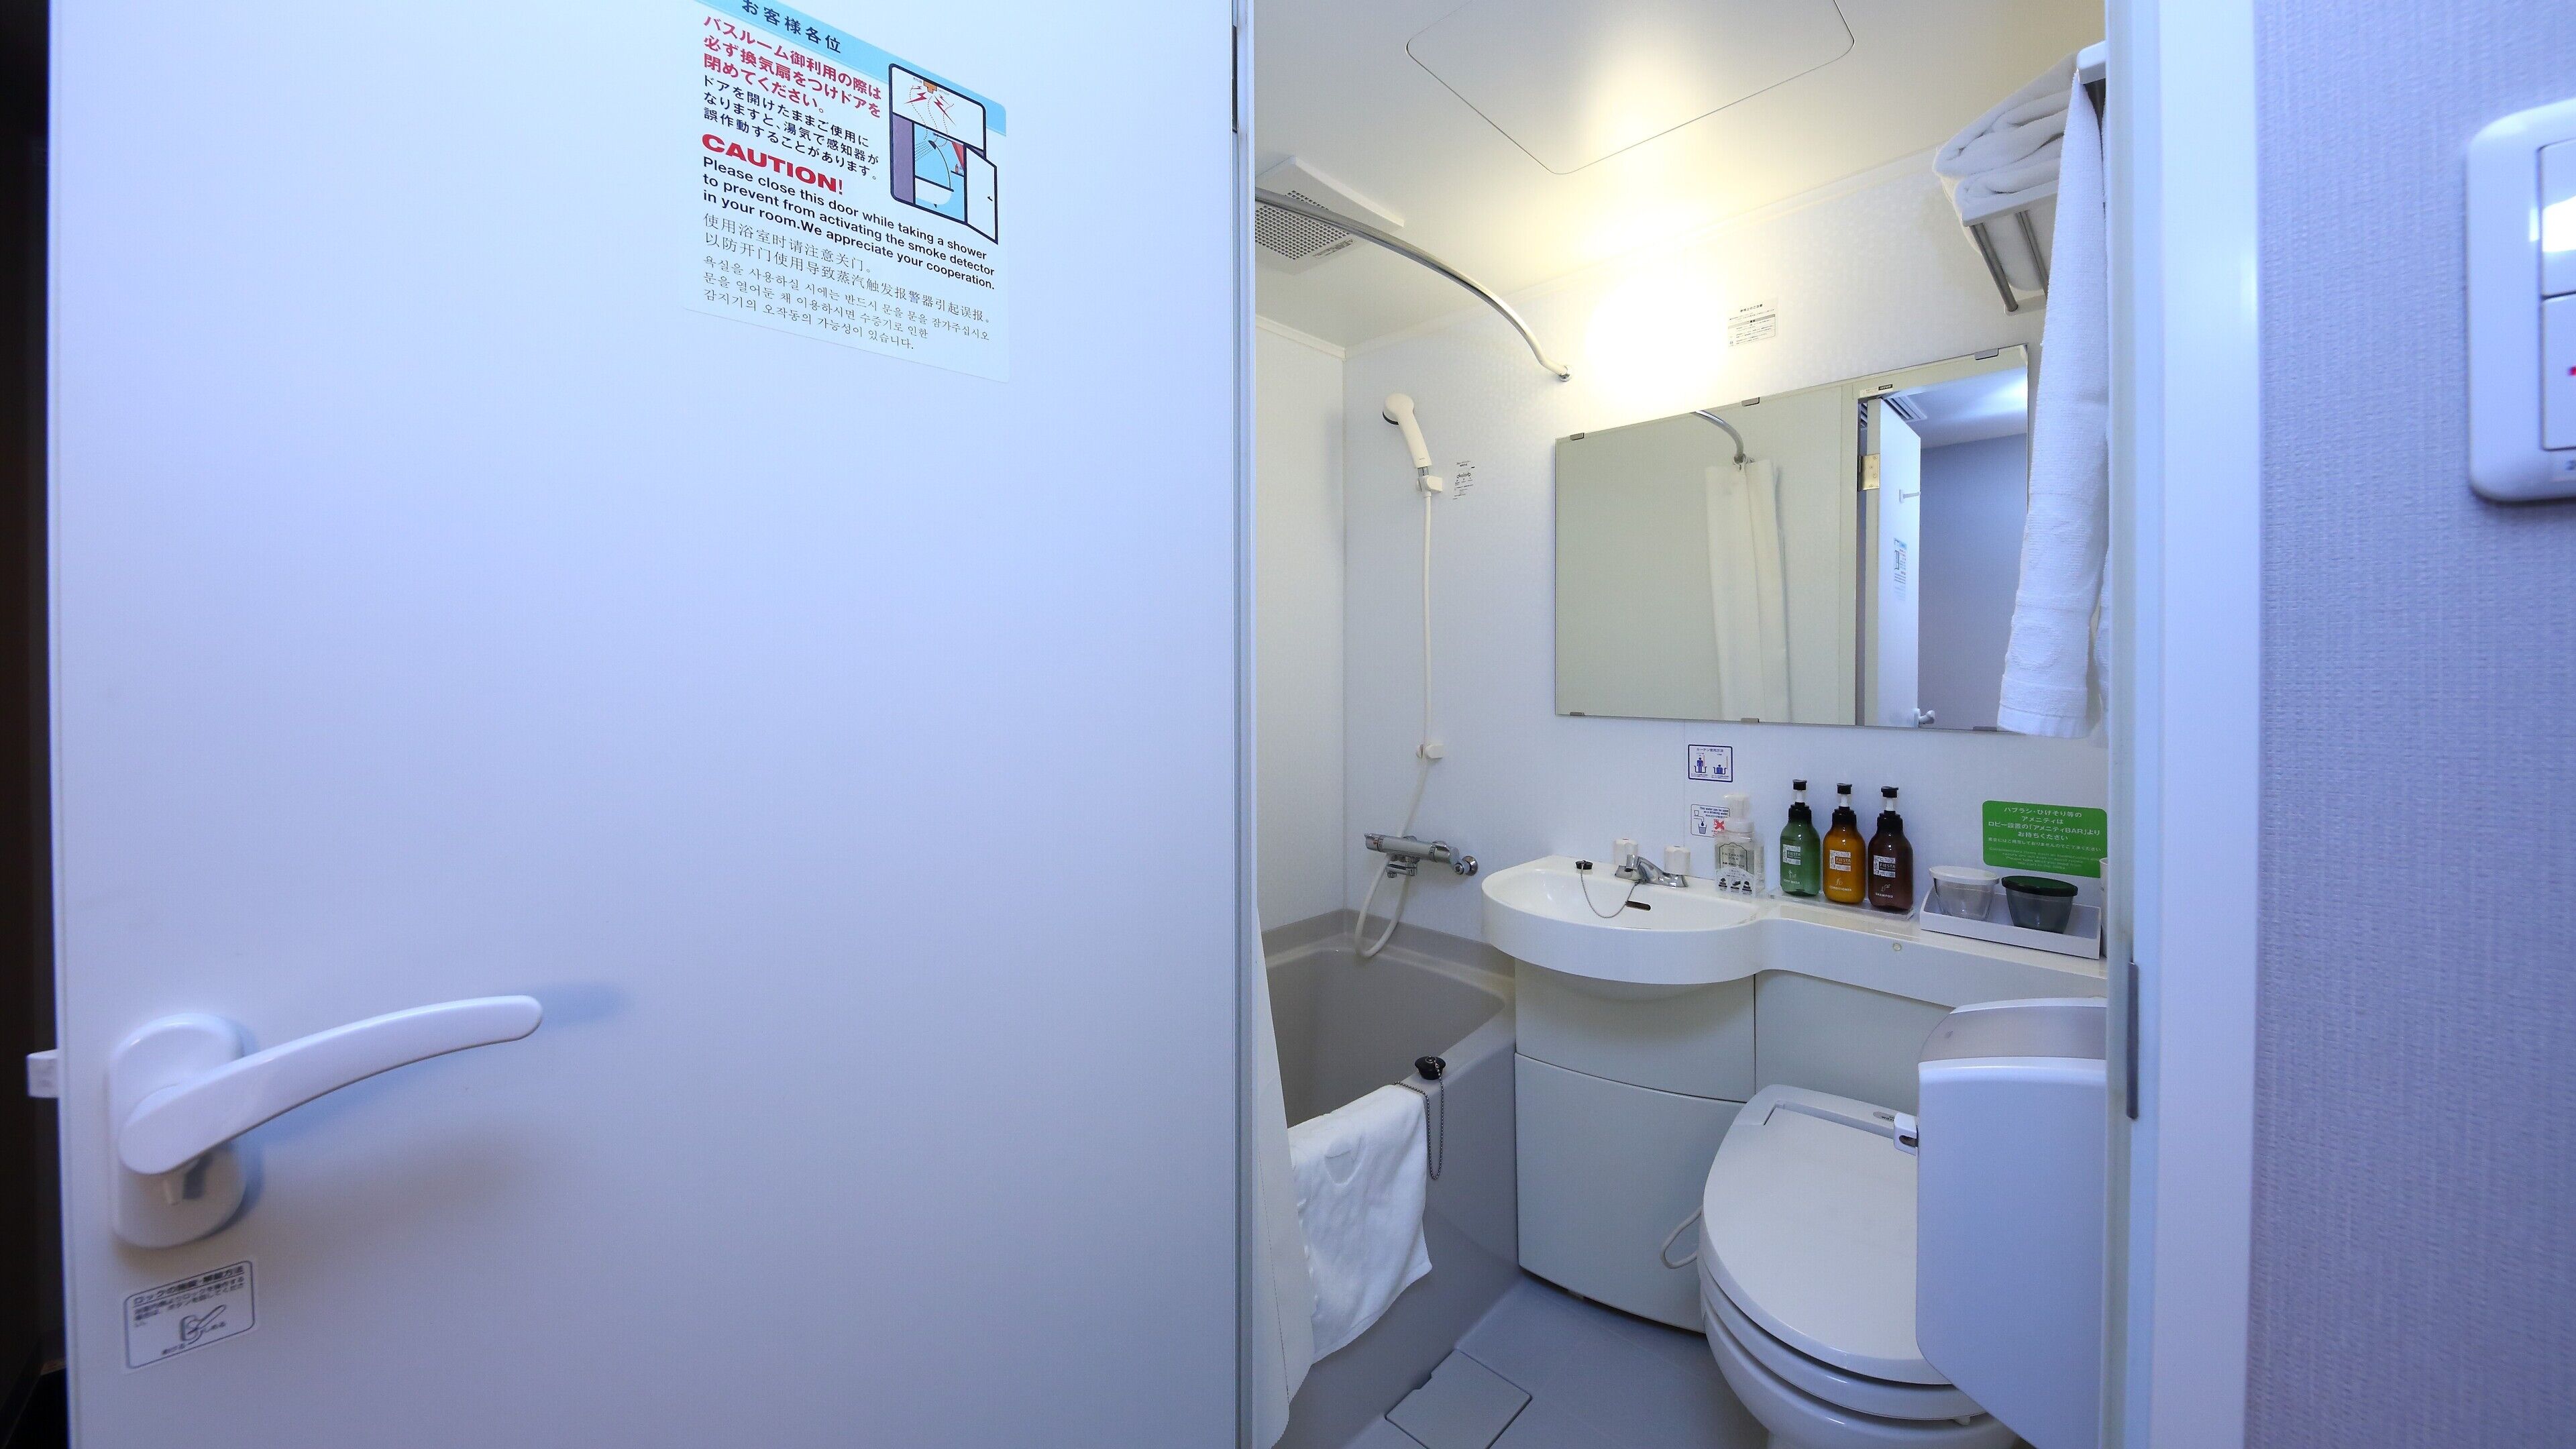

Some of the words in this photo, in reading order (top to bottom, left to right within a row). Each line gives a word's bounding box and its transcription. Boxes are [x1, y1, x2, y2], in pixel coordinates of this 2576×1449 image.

[704, 16, 881, 100] バスルーム御利用の際は
[742, 0, 841, 54] お客様各位
[704, 35, 880, 118] 必ず換気扇をつけドアを
[704, 53, 824, 113] 閉めてください。
[704, 75, 869, 148] ドアを開けたままご使用に
[702, 133, 843, 195] CAUTION!
[704, 92, 879, 165] なりますと、湯気で感知器が
[704, 107, 876, 180] 誤作動することがあります。
[703, 173, 718, 187] to
[723, 181, 780, 207] prevent
[783, 199, 815, 219] from
[819, 213, 881, 241] activating
[885, 233, 904, 247] the
[908, 241, 947, 260] smoke
[950, 254, 995, 276] detector
[703, 189, 716, 203] in
[721, 197, 755, 215] your
[826, 230, 894, 258] appreciate
[897, 252, 923, 267] your
[926, 262, 995, 290] cooperation.
[704, 156, 753, 182] Please
[758, 177, 796, 196] close
[800, 189, 824, 206] this
[828, 200, 859, 217] door
[863, 211, 894, 229] while
[898, 222, 934, 244] taking
[937, 237, 944, 246] a
[947, 240, 987, 260] shower
[704, 213, 870, 273] 使用浴室时请注意关门。
[704, 256, 743, 276] 욕실을
[749, 268, 799, 291] 사용하실
[805, 283, 840, 301] 시에는
[845, 294, 877, 311] 반드시
[882, 303, 903, 319] 문을
[907, 311, 928, 325] 문을
[932, 317, 989, 341] 잠가주십시오
[704, 272, 730, 288] 문을
[736, 280, 774, 299] 열어둔
[781, 292, 791, 304] 채
[796, 297, 855, 321] 이용하시면
[908, 325, 928, 339] 인한
[705, 232, 989, 323] 以防开门使用导致蒸汽触发报警器引起误报。
[704, 289, 756, 311] 감지기의
[763, 304, 812, 325] 오작동의
[818, 317, 863, 337] 가능성이
[868, 329, 914, 350] 있습니다.
[2017, 831, 2068, 841] お待ちください
[2021, 816, 2063, 824] アメニティは
